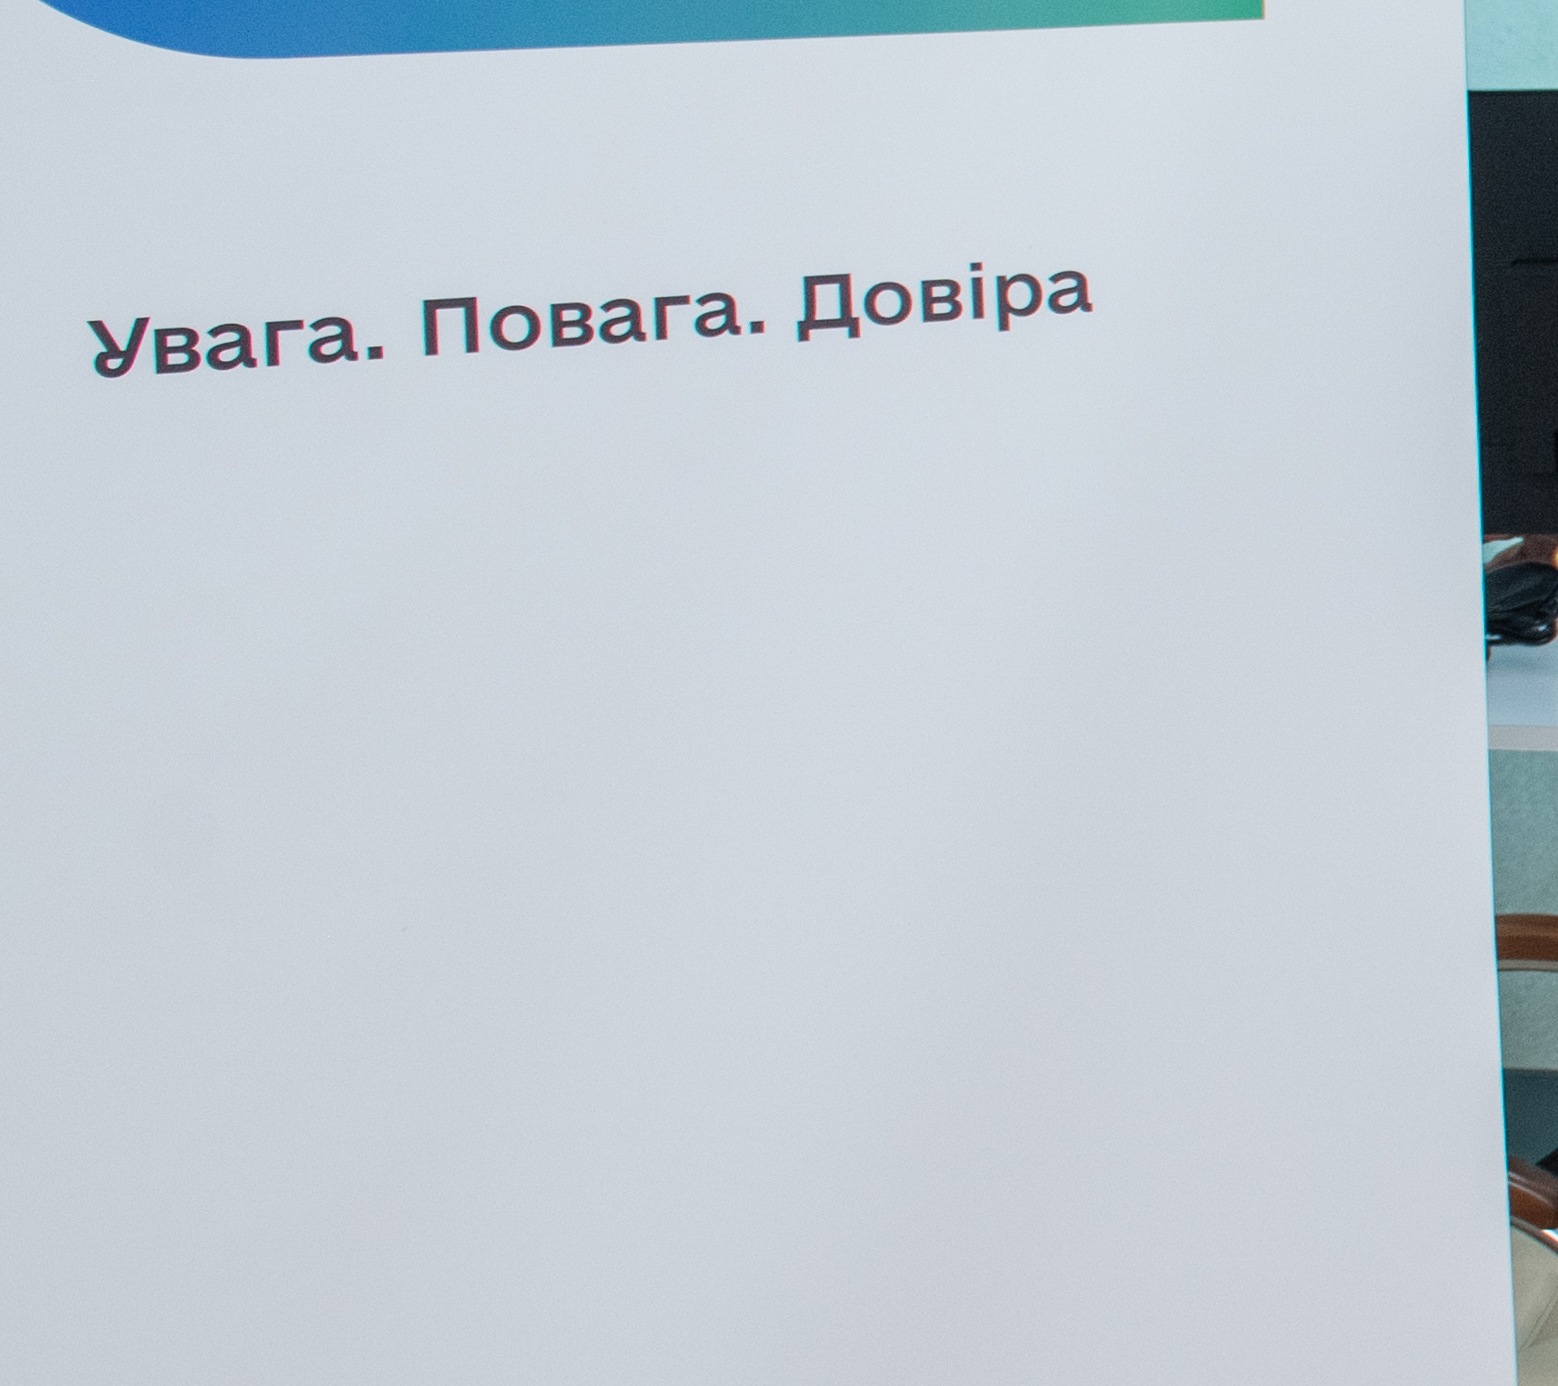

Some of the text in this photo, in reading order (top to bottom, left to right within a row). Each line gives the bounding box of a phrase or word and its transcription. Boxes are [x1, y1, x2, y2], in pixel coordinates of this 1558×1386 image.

[88, 261, 1095, 380] Увага. Повага. Довіра
